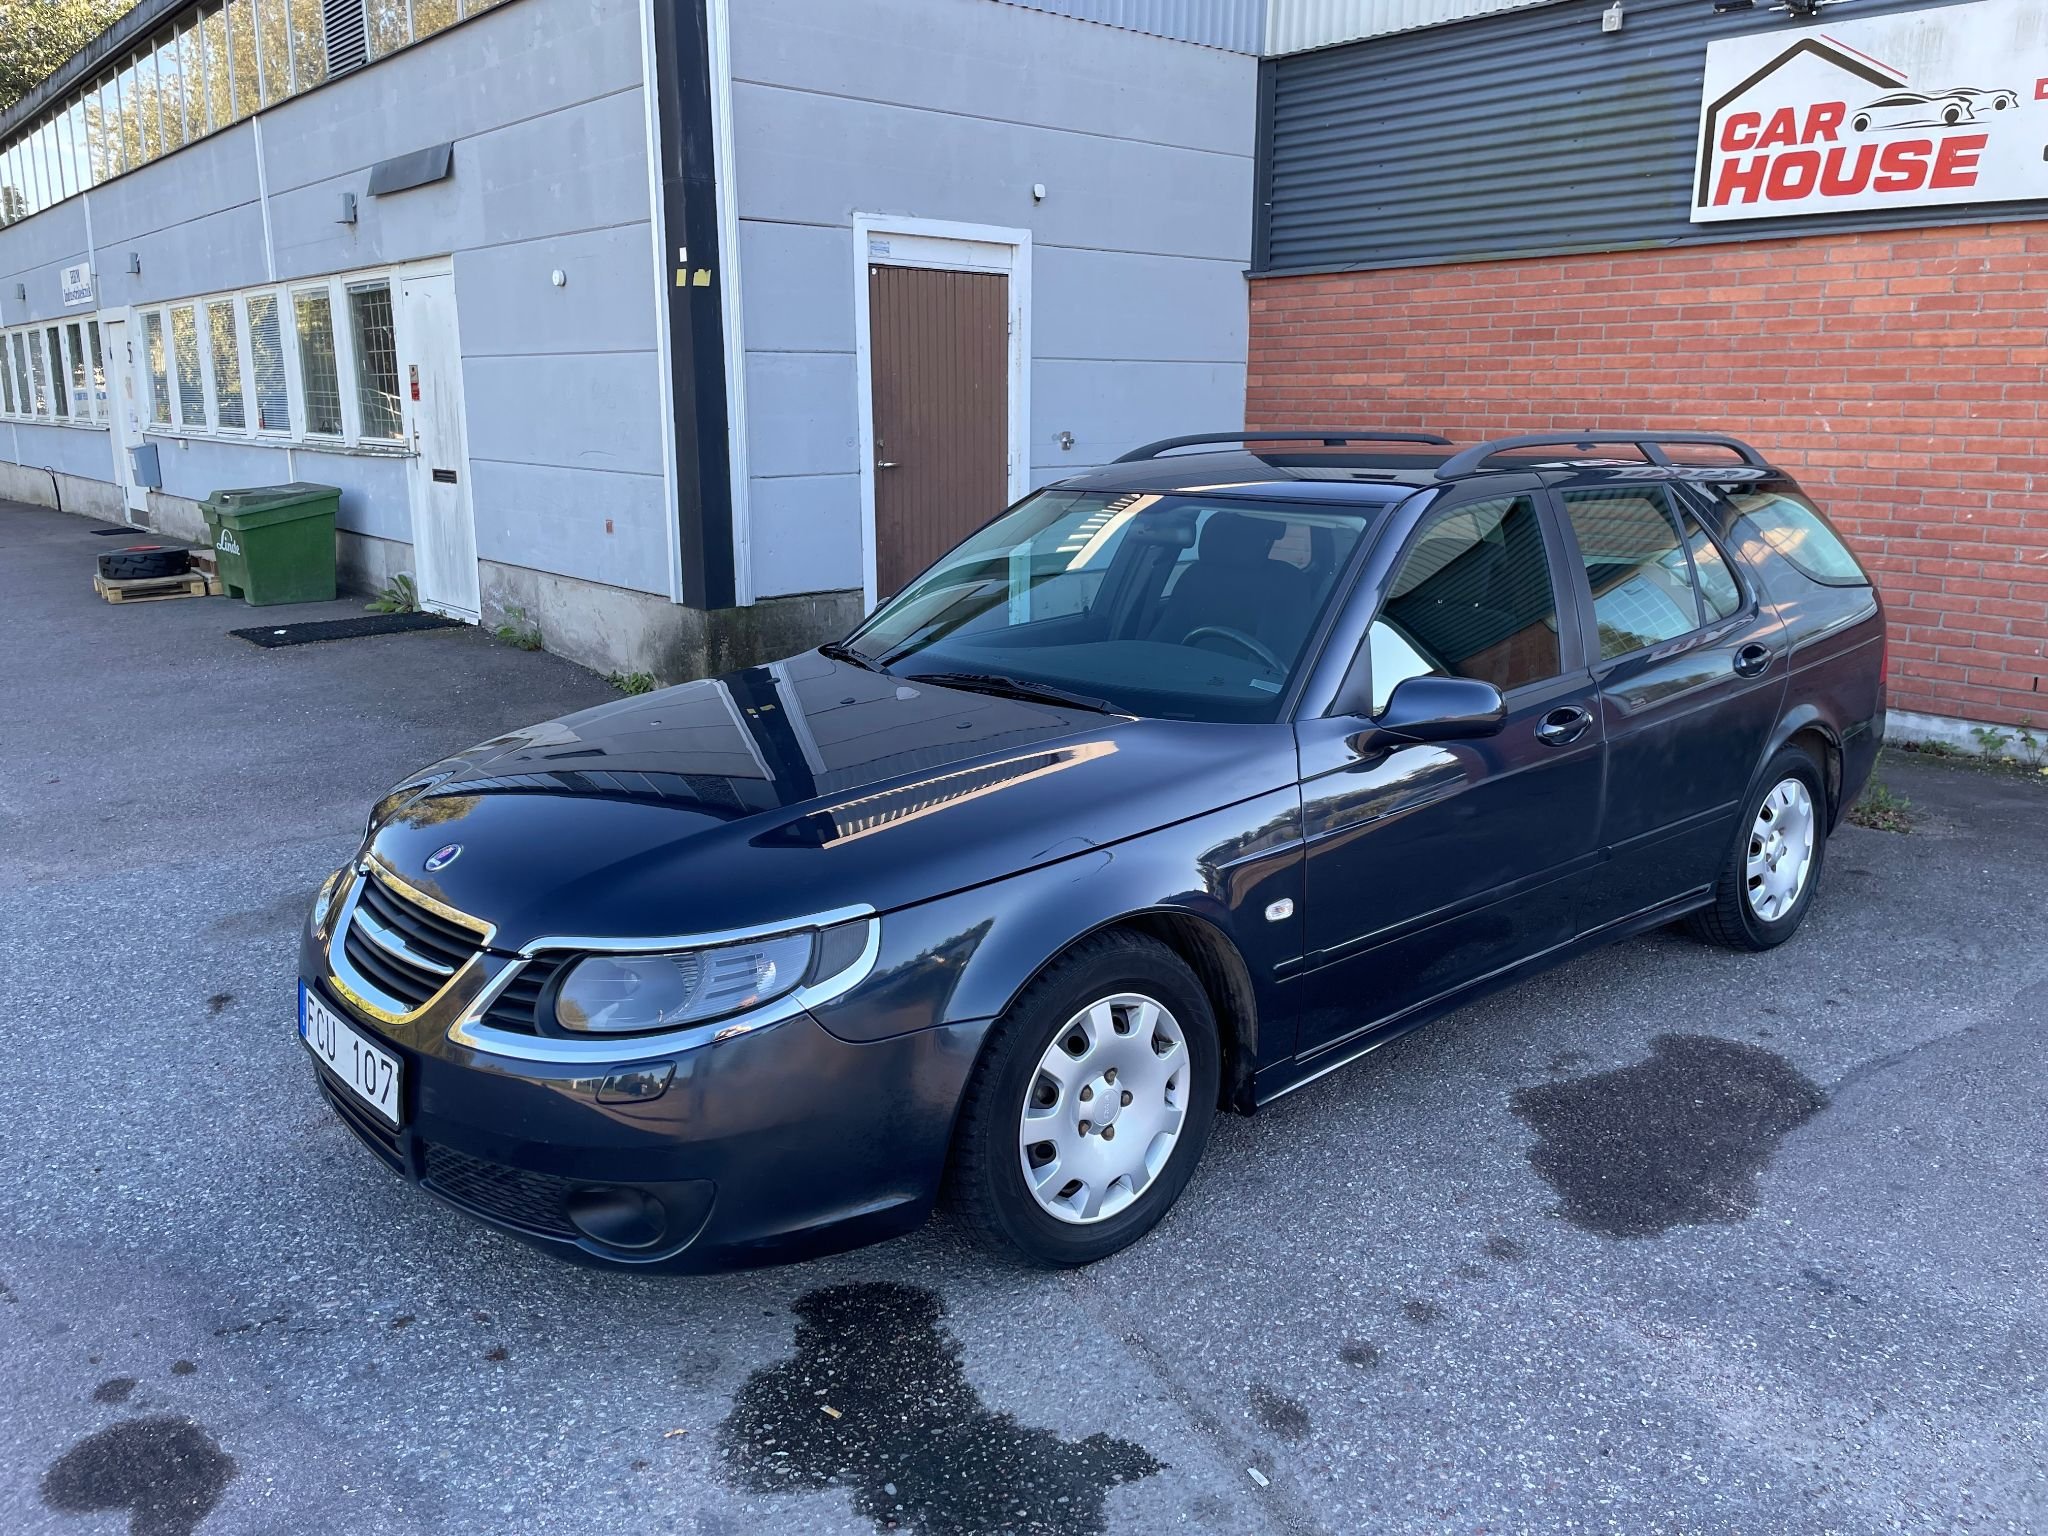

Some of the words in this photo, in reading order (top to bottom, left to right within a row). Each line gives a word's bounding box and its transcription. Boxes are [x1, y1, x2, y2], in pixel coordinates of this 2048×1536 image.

[1720, 101, 1846, 152] CAR
[1713, 134, 1989, 206] HOUSE
[216, 528, 240, 556] Linde
[307, 995, 336, 1062] FCU
[353, 1040, 393, 1105] 107
